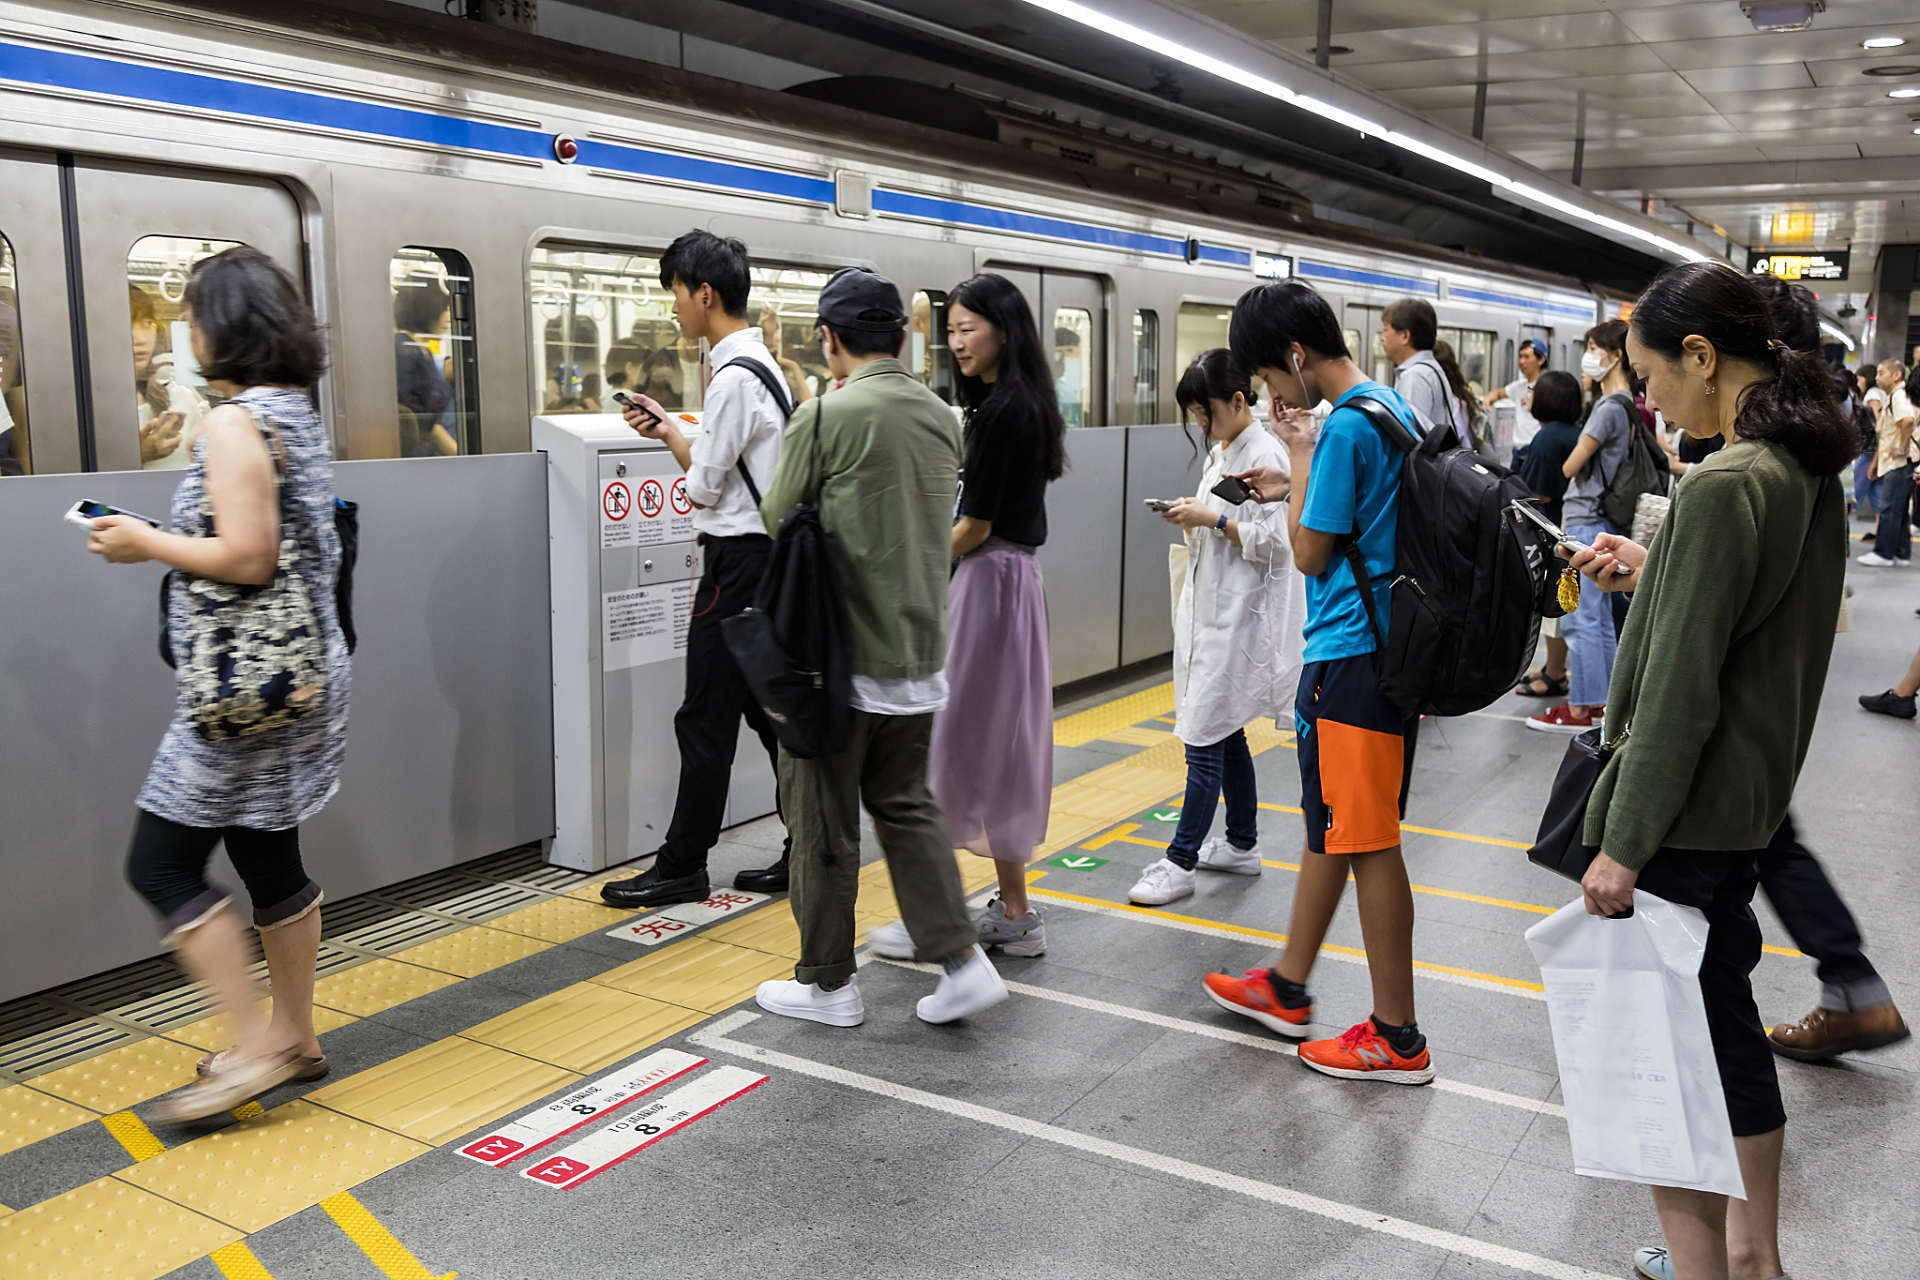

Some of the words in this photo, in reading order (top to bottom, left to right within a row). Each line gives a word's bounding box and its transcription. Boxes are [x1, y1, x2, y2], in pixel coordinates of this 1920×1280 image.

[631, 892, 753, 939] 先発
[571, 1104, 597, 1115] 8
[634, 1123, 661, 1135] 8
[475, 1138, 510, 1157] TY
[539, 1159, 574, 1178] TY
